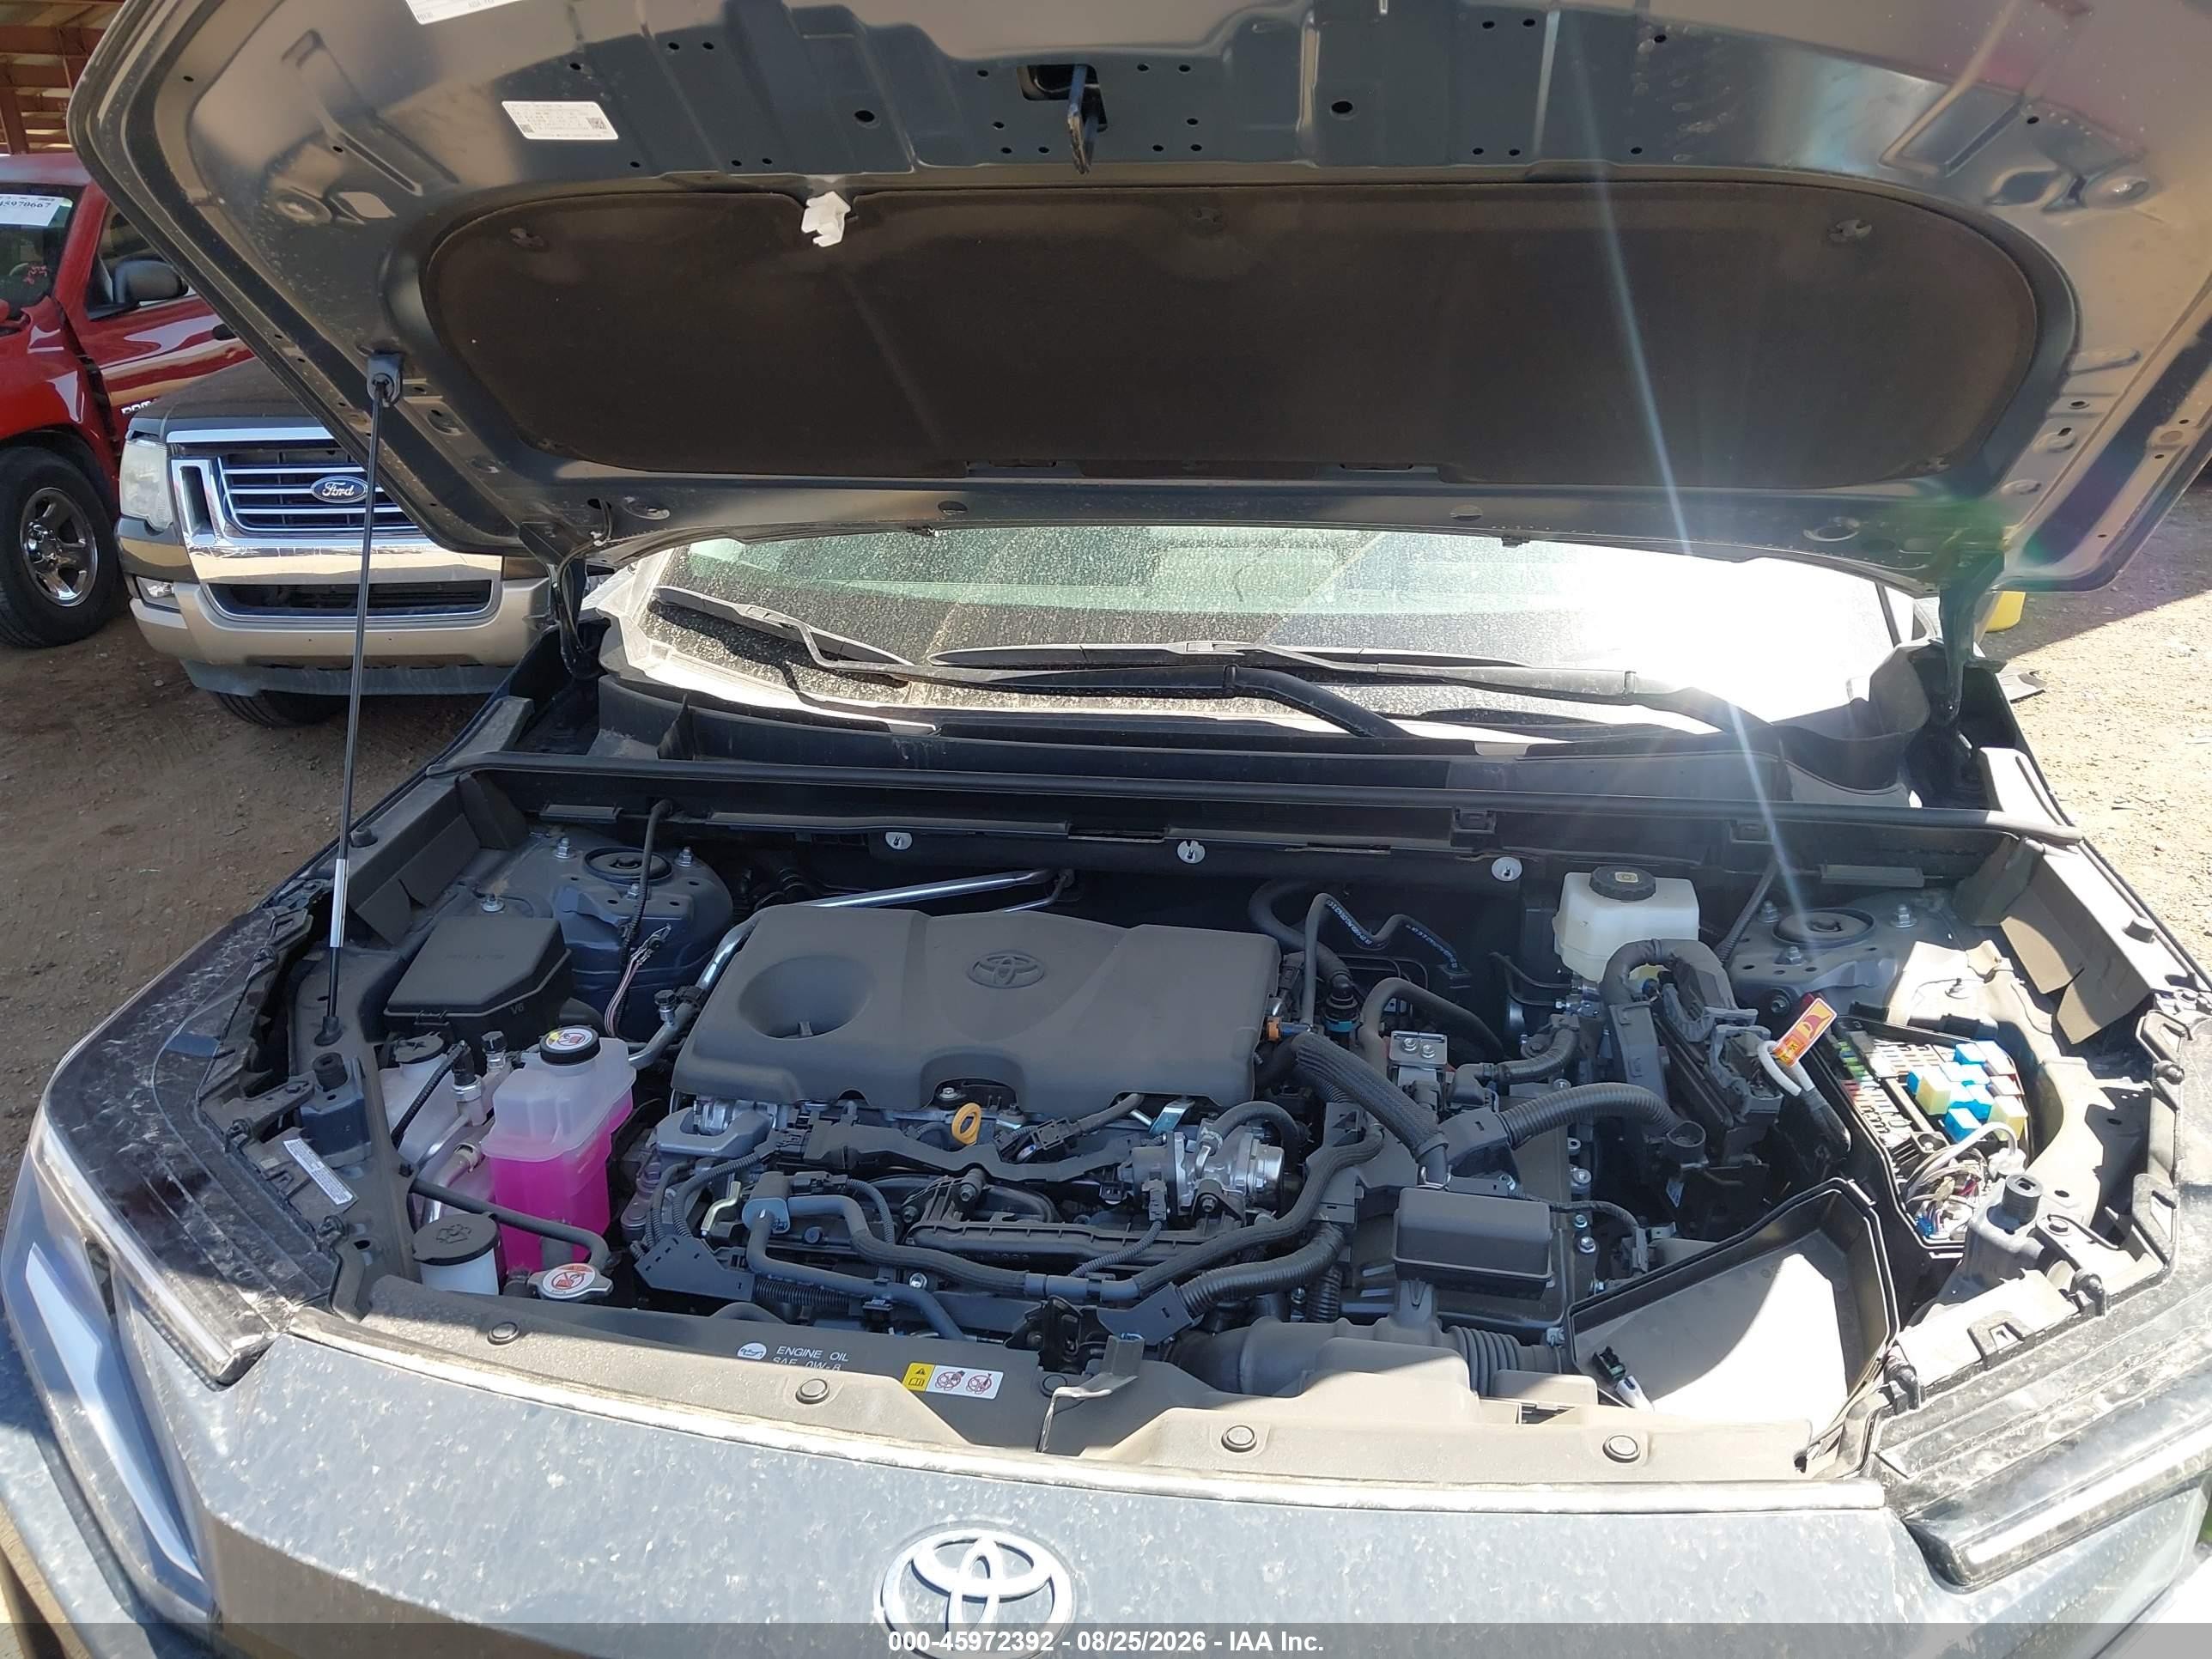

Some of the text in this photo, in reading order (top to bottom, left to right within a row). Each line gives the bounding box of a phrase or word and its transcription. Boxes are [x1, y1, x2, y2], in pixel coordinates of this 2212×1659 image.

[321, 481, 355, 496] Ford
[775, 1346, 849, 1362] ENGINE OIL
